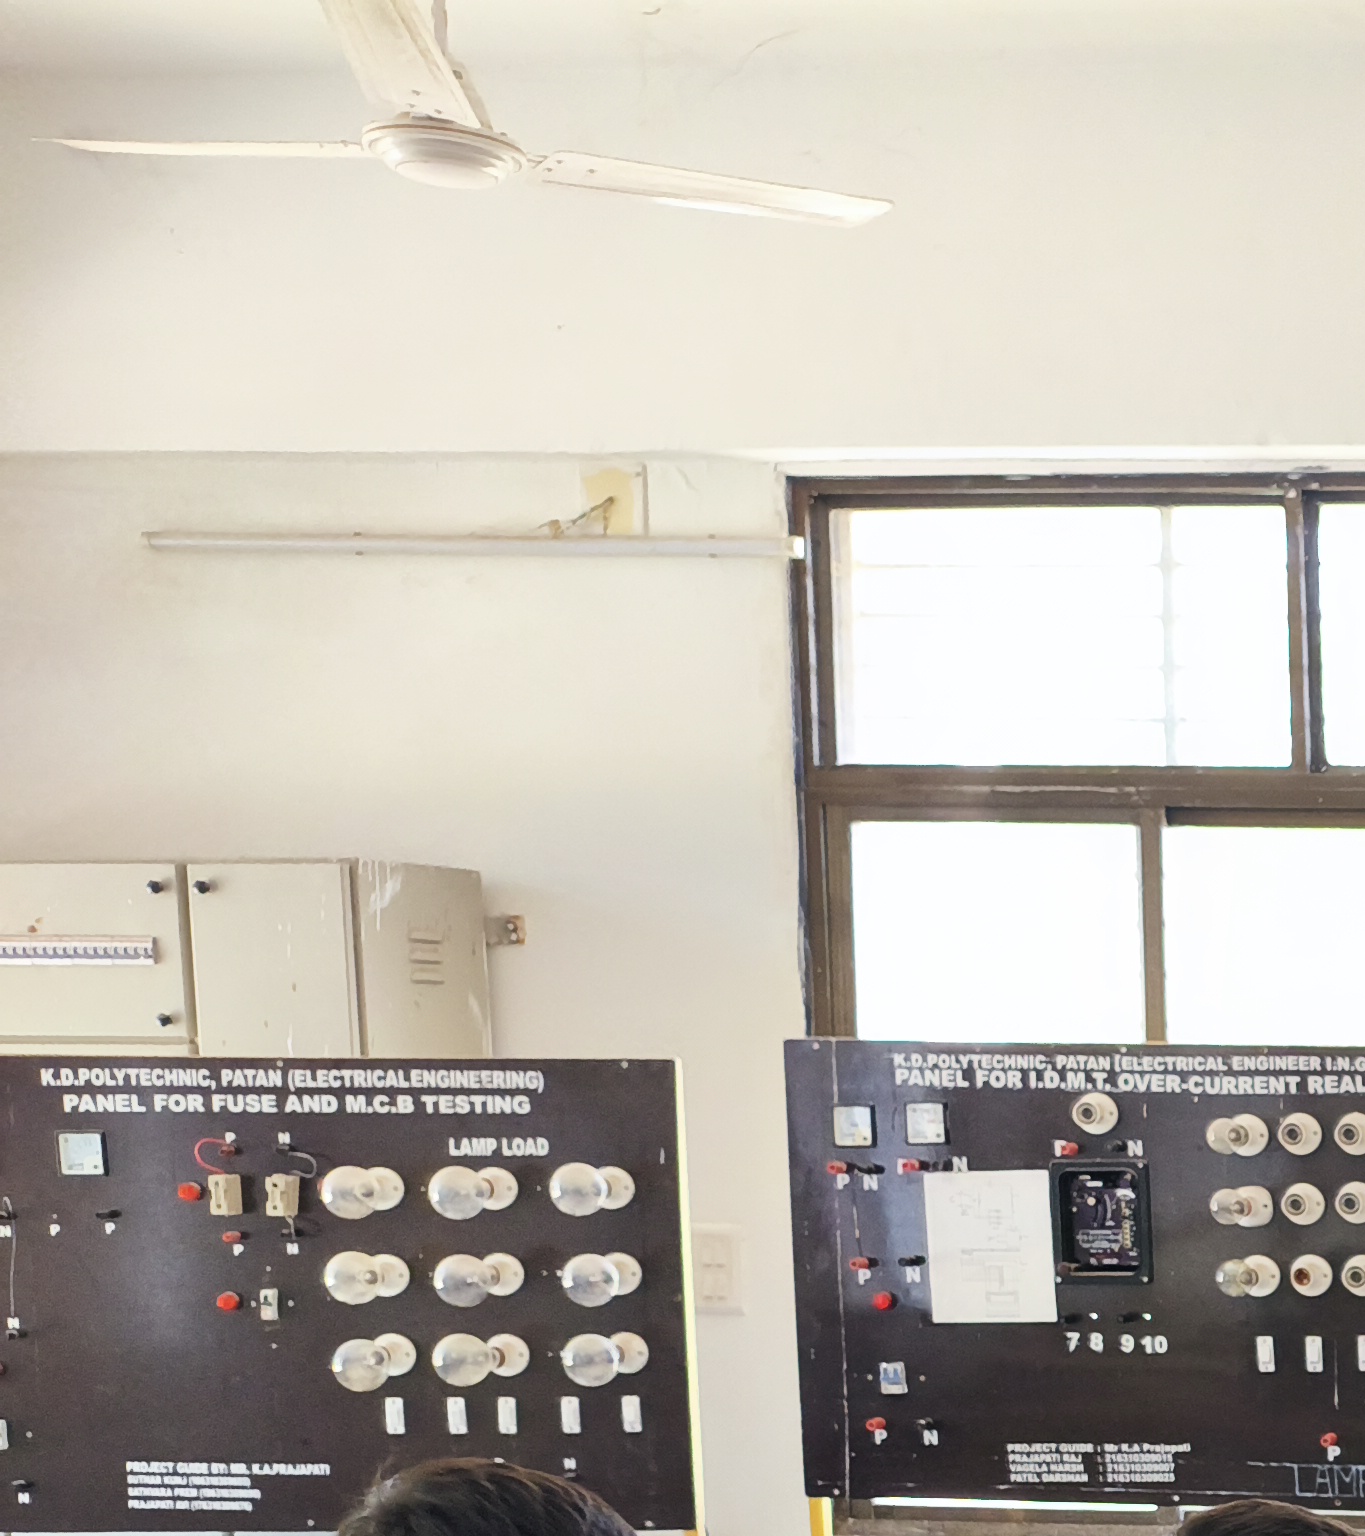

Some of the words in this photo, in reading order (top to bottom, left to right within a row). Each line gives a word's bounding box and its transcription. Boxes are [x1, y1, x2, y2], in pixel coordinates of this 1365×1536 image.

[893, 1052, 1052, 1072] K.D.POLYTECHNIC,
[1056, 1054, 1111, 1071] PATAN
[1232, 1055, 1322, 1072] ENGINEER
[40, 1067, 217, 1091] K.D.POLYTECHNIC,
[220, 1068, 282, 1088] PATAN
[894, 1068, 970, 1088] PANEL
[975, 1069, 1023, 1090] FOR
[1117, 1072, 1301, 1095] OVER-CURRENT
[62, 1093, 147, 1113] PANEL
[152, 1093, 206, 1113] FOR
[211, 1093, 279, 1113] FUSE
[284, 1094, 339, 1114] AND
[345, 1094, 415, 1114] M.C.B
[420, 1094, 532, 1115] TESTING
[448, 1136, 498, 1157] LAMP
[501, 1136, 550, 1157] LOAD
[1126, 1139, 1144, 1157] N
[951, 1155, 968, 1172] N
[836, 1173, 850, 1190] P
[862, 1174, 879, 1191] N
[857, 1268, 872, 1285] P
[905, 1265, 921, 1283] N
[1065, 1331, 1081, 1352] 7
[1087, 1332, 1104, 1353] 8
[1118, 1333, 1135, 1354] 9
[1140, 1334, 1169, 1355] 10
[874, 1428, 888, 1446] P
[922, 1428, 939, 1446] N
[1326, 1444, 1342, 1462] P
